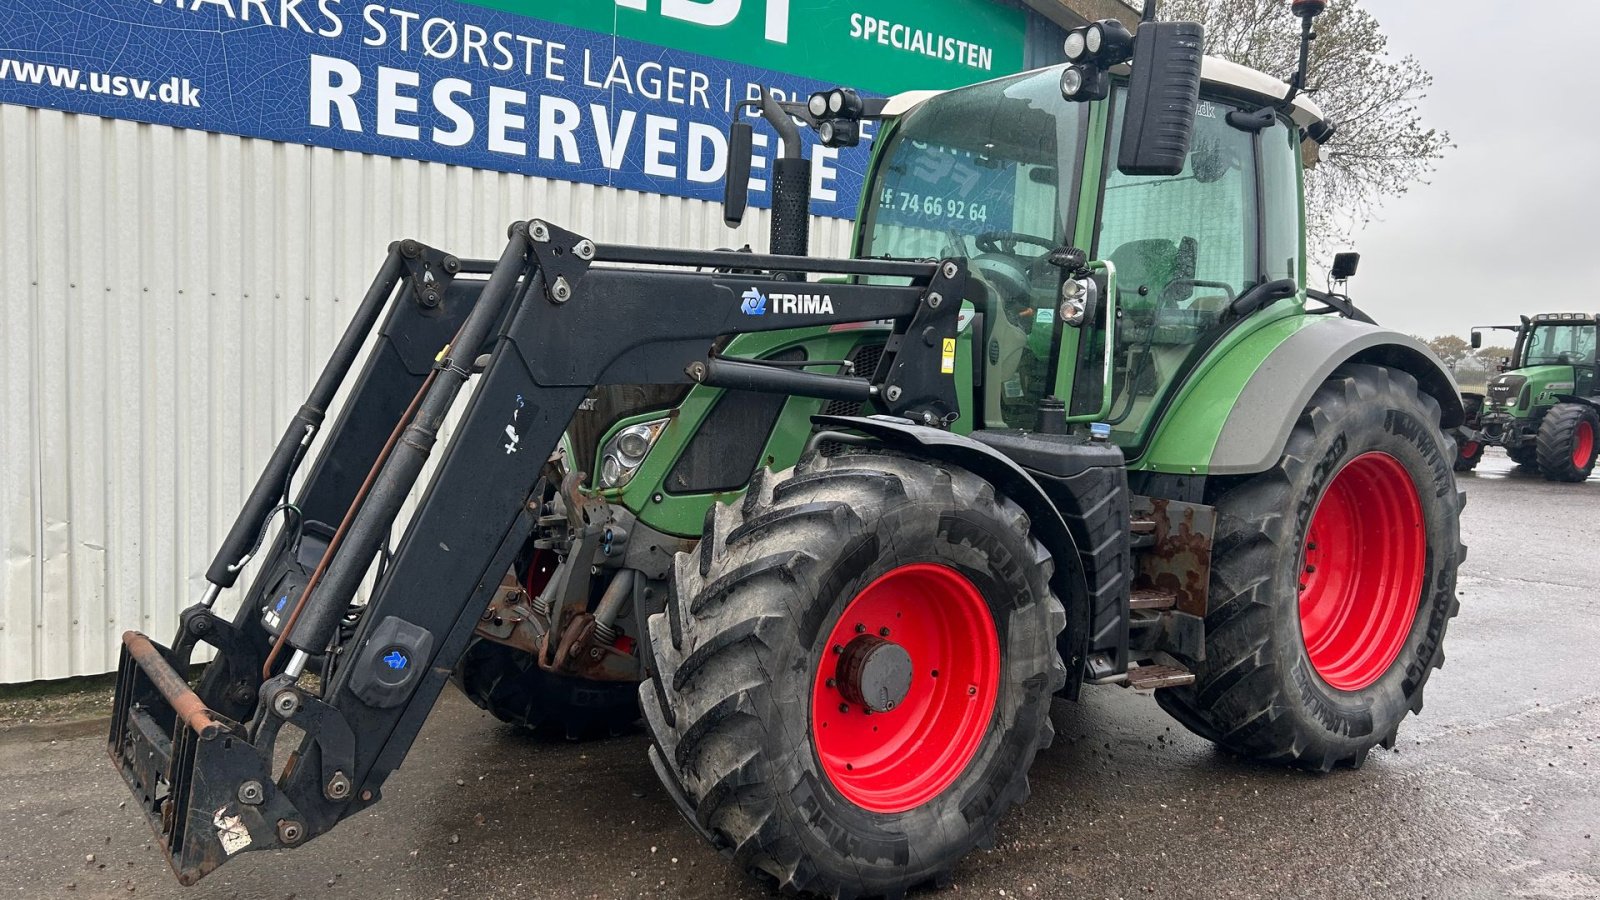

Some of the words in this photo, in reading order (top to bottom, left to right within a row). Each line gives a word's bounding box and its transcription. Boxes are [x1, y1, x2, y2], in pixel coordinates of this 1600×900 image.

[362, 4, 566, 82] STØRSTE
[583, 49, 710, 109] LAGER
[724, 78, 731, 113] I
[850, 13, 992, 71] SPECIALISTEN
[310, 53, 839, 202] RESERVEDEE
[900, 192, 919, 212] 74
[923, 195, 943, 216] 66
[947, 199, 965, 219] 92
[969, 203, 987, 222] 64
[768, 293, 835, 315] TRIMA
